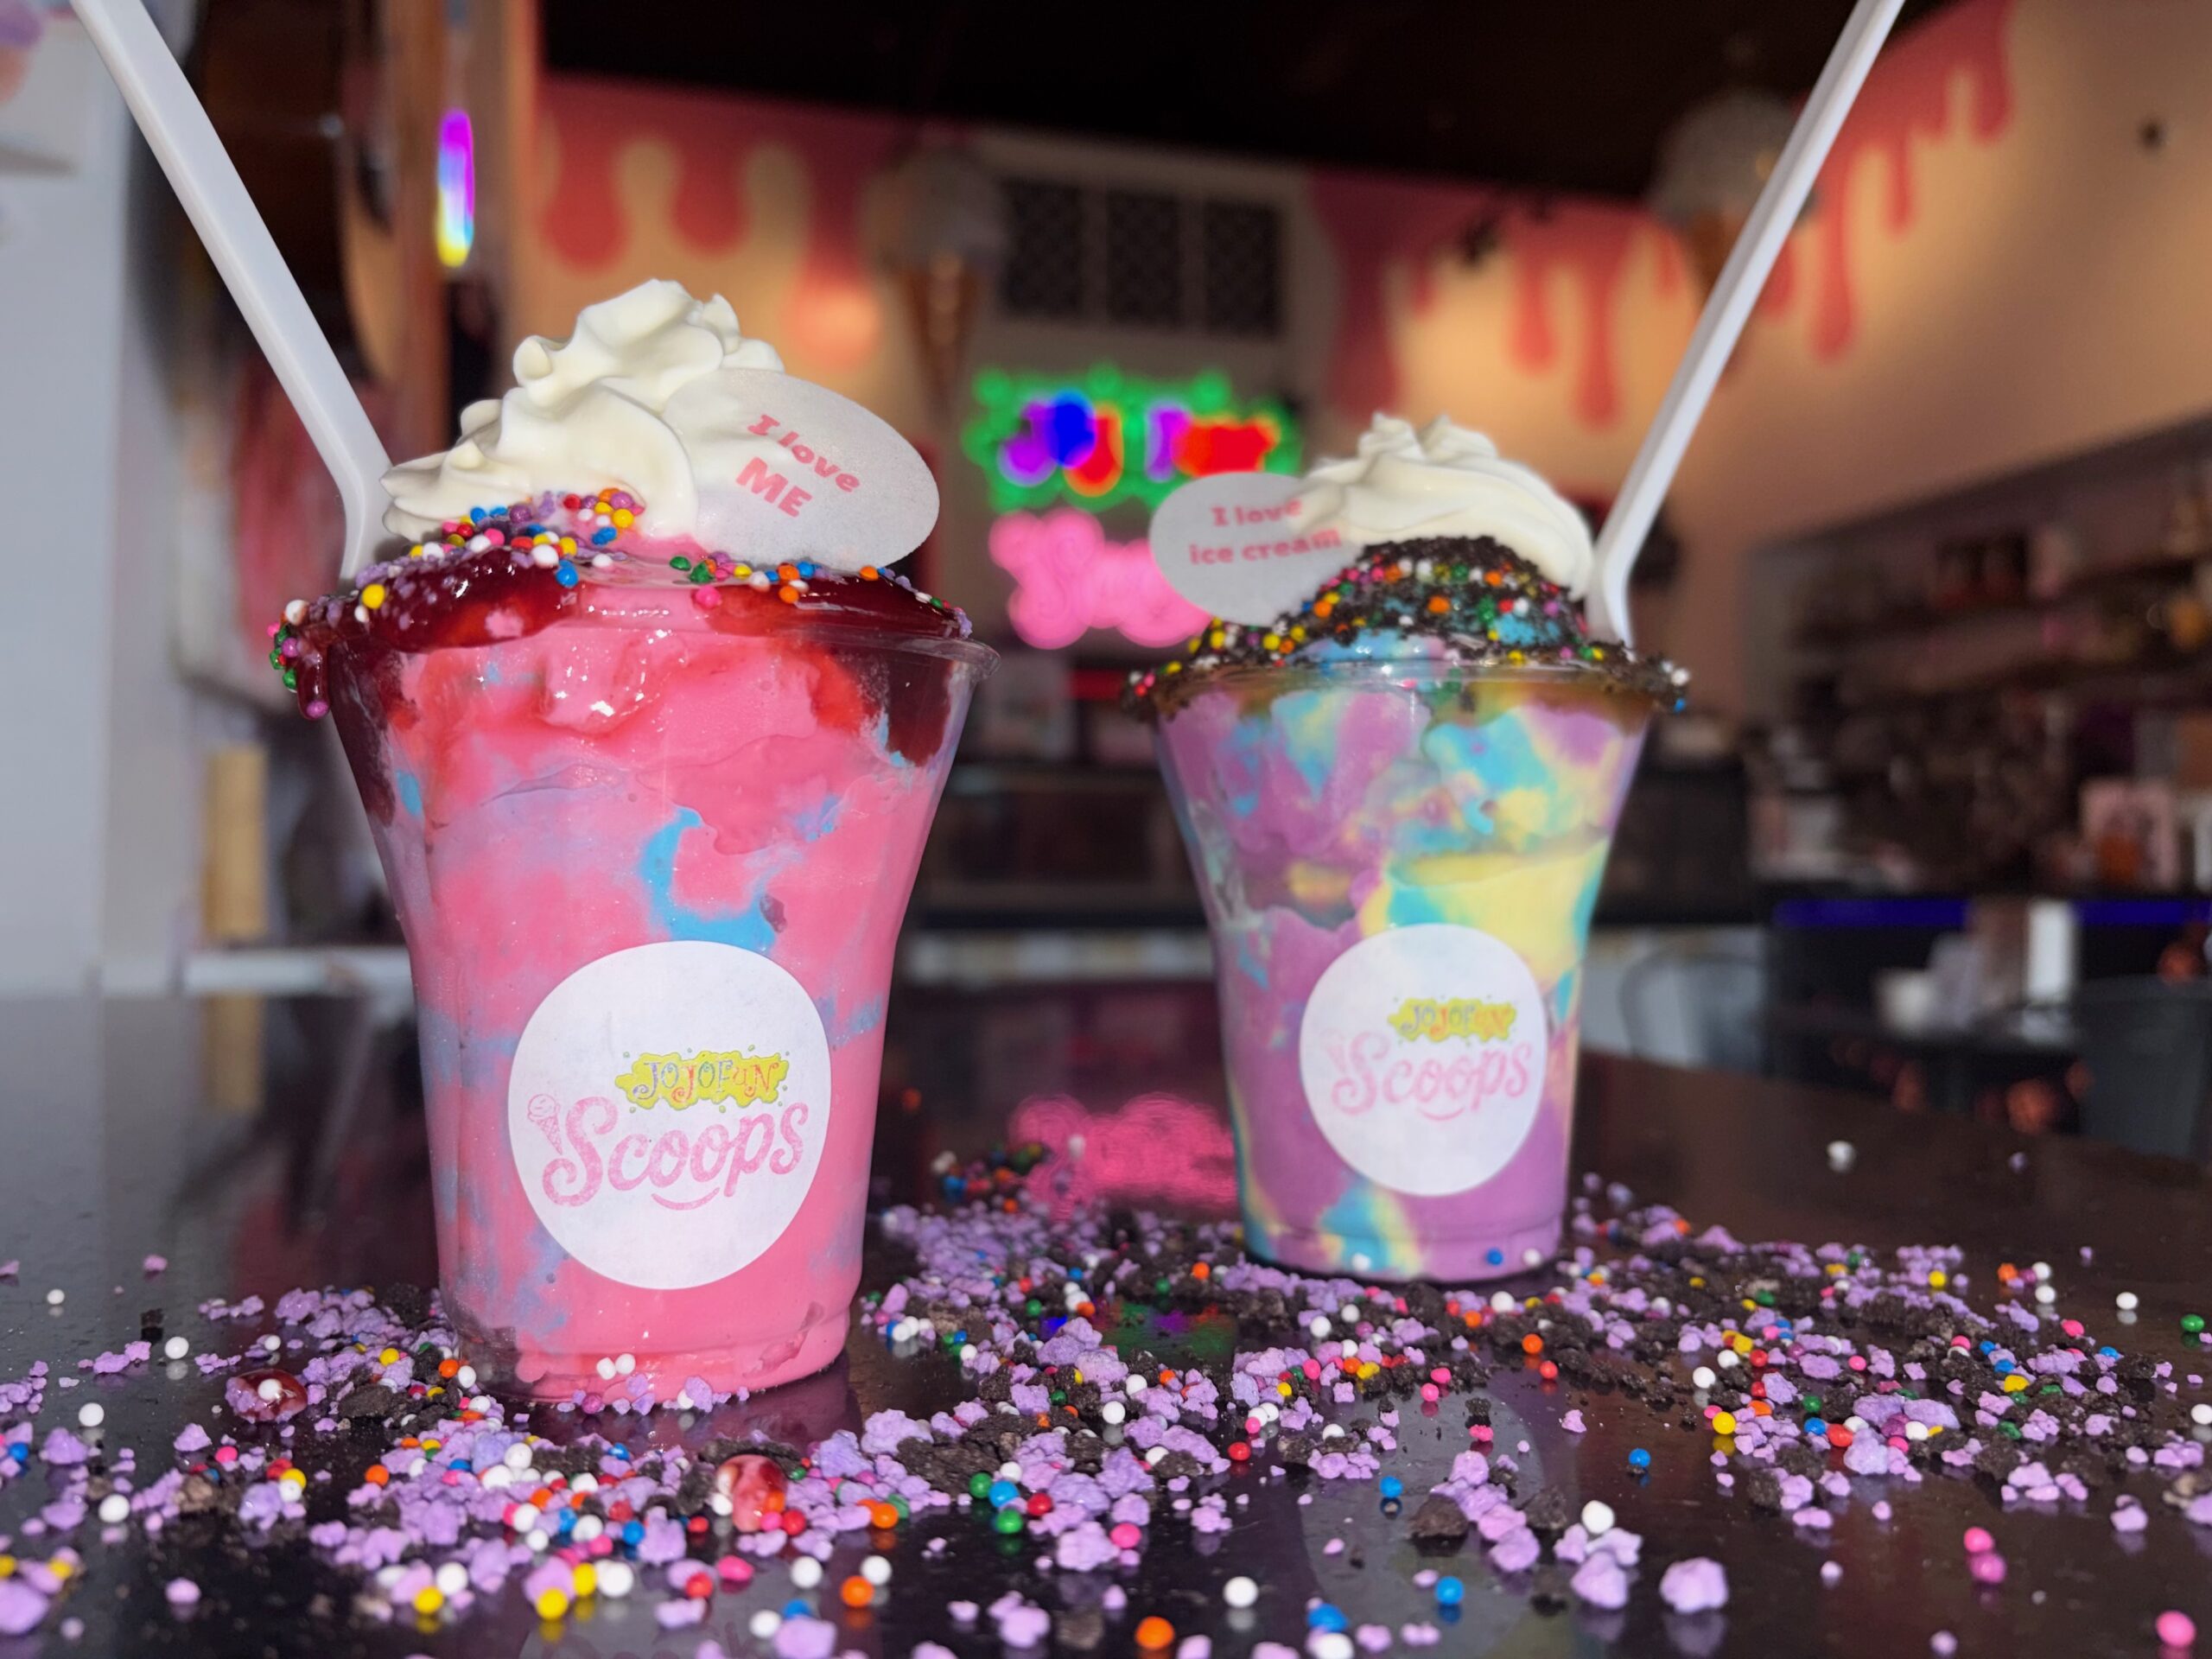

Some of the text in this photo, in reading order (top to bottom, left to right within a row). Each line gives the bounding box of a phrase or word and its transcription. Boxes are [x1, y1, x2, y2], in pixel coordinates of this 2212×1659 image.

[735, 456, 812, 518] ME
[747, 414, 861, 493] I love
[1188, 528, 1341, 564] ice cream
[1211, 499, 1302, 526] I love
[1331, 1030, 1534, 1116] Scoops
[542, 1096, 810, 1206] Scoops
